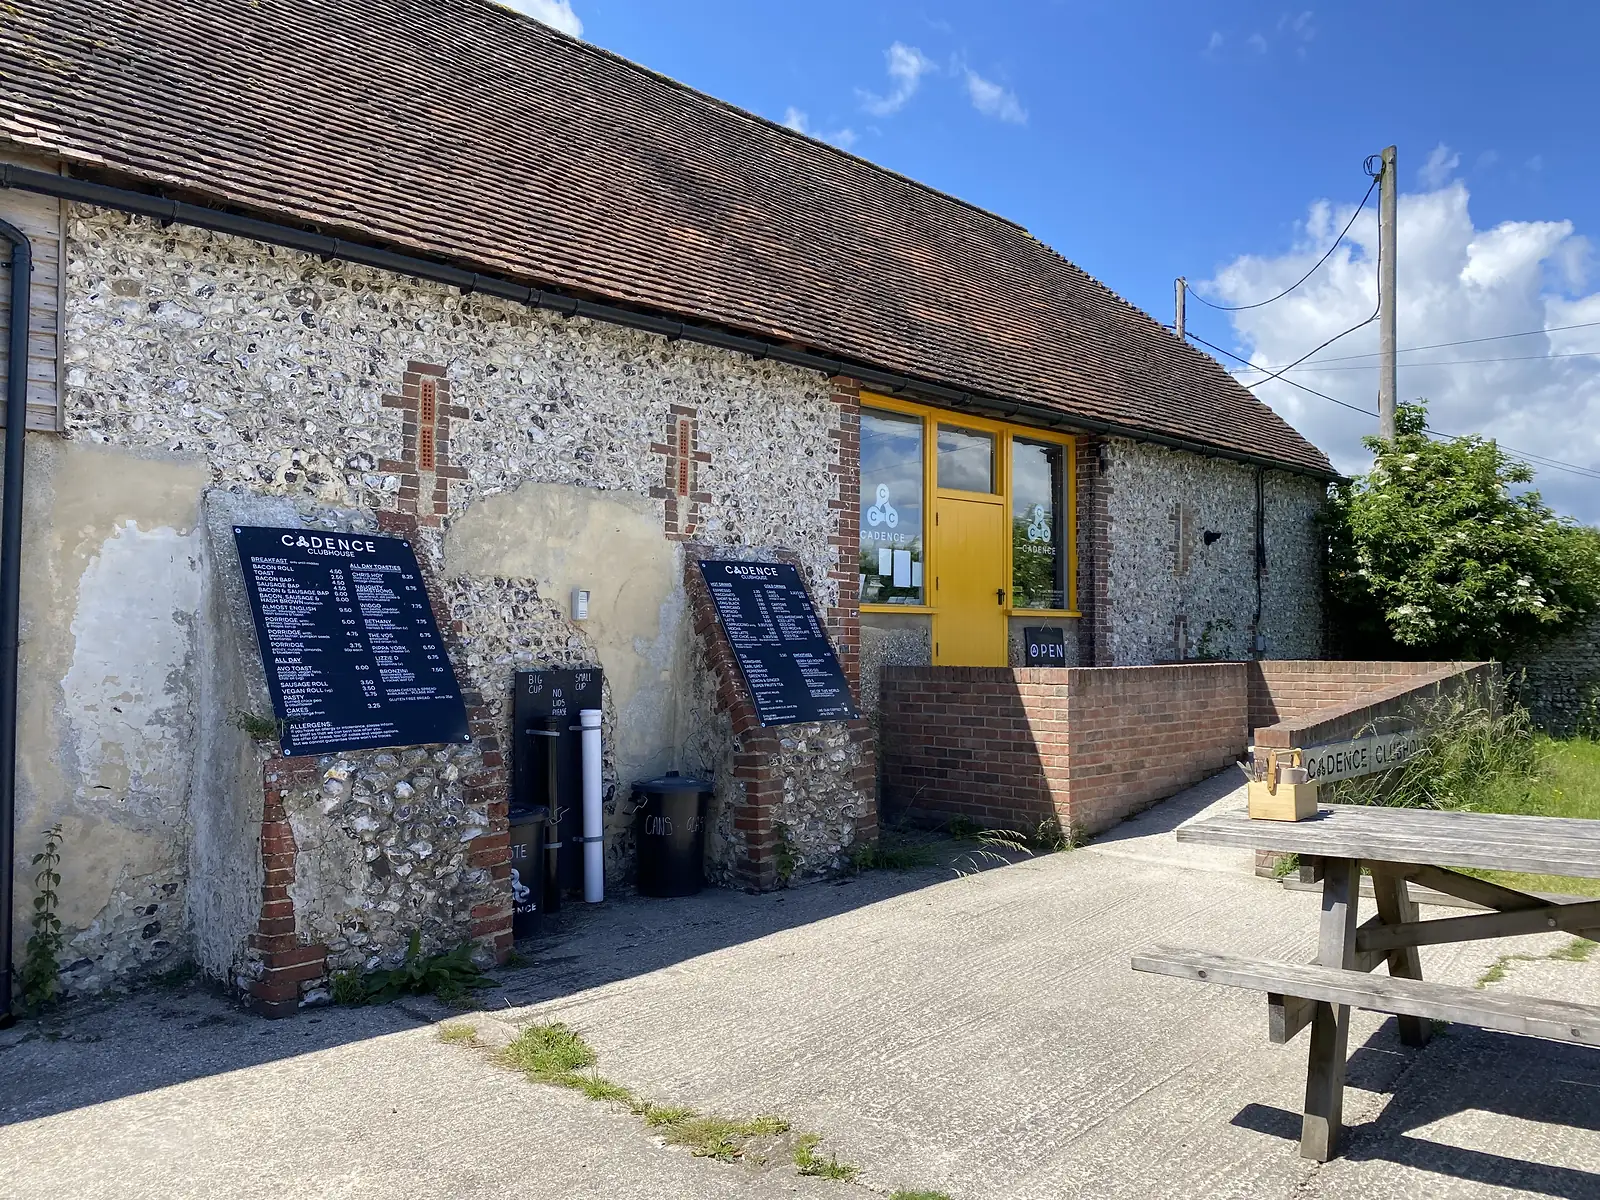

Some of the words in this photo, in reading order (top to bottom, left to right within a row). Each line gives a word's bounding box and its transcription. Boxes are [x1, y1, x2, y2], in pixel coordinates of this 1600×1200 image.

[860, 531, 905, 542] CADENCE
[281, 535, 376, 553] CADENCE
[307, 548, 355, 558] CLUBHOUSE
[1022, 544, 1056, 555] CADENCE
[251, 556, 288, 564] BREAKFAST
[725, 566, 778, 576] CADENCE
[1030, 644, 1063, 658] OPEN
[528, 674, 543, 684] BIG
[576, 672, 592, 682] SMALL
[528, 684, 543, 694] CUP
[576, 682, 586, 690] CUP
[552, 688, 562, 698] NO
[552, 699, 566, 707] LIDS
[290, 721, 332, 730] ALLERGENS:
[1307, 748, 1367, 778] CADENCE
[646, 814, 673, 836] CANS
